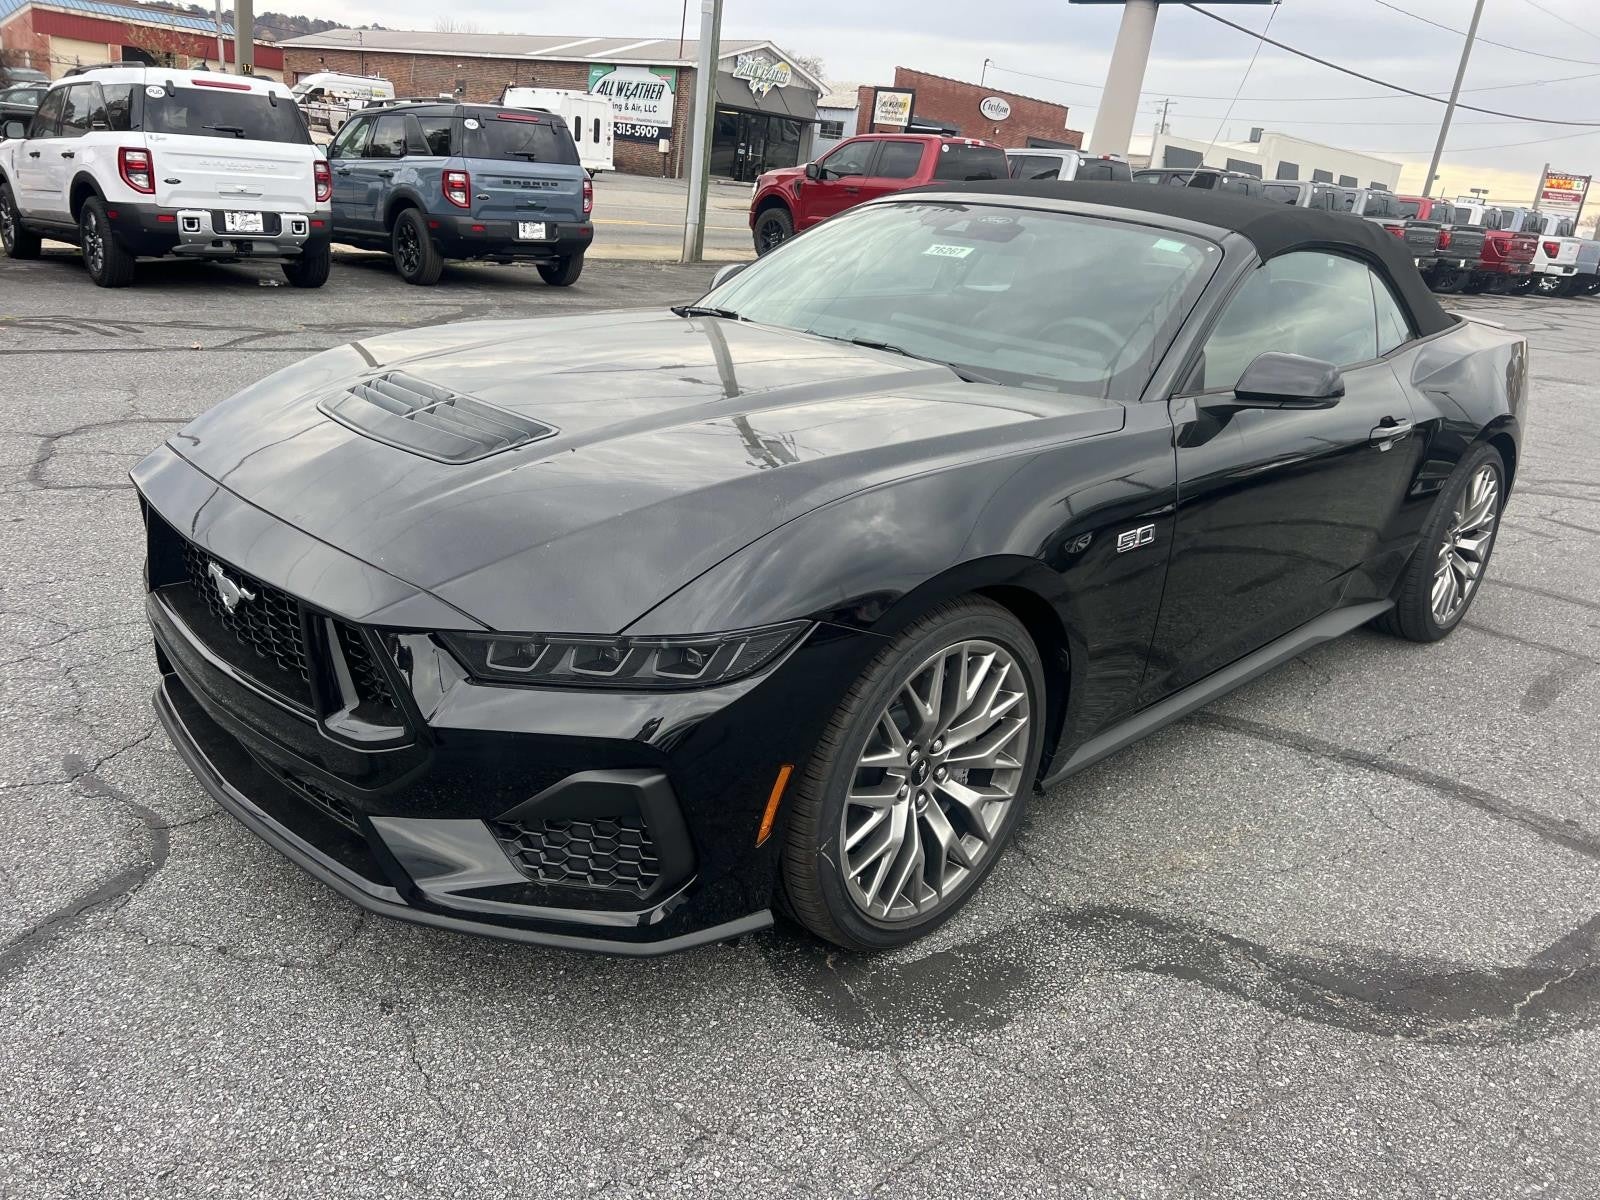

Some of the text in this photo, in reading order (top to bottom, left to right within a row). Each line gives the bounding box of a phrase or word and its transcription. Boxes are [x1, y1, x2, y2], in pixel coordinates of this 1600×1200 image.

[596, 80, 665, 100] ALL WEATHER
[612, 102, 622, 111] ing
[631, 103, 642, 113] Air,
[644, 104, 658, 113] LLC
[613, 123, 659, 138] -315-5909
[502, 179, 559, 187] BRONCO
